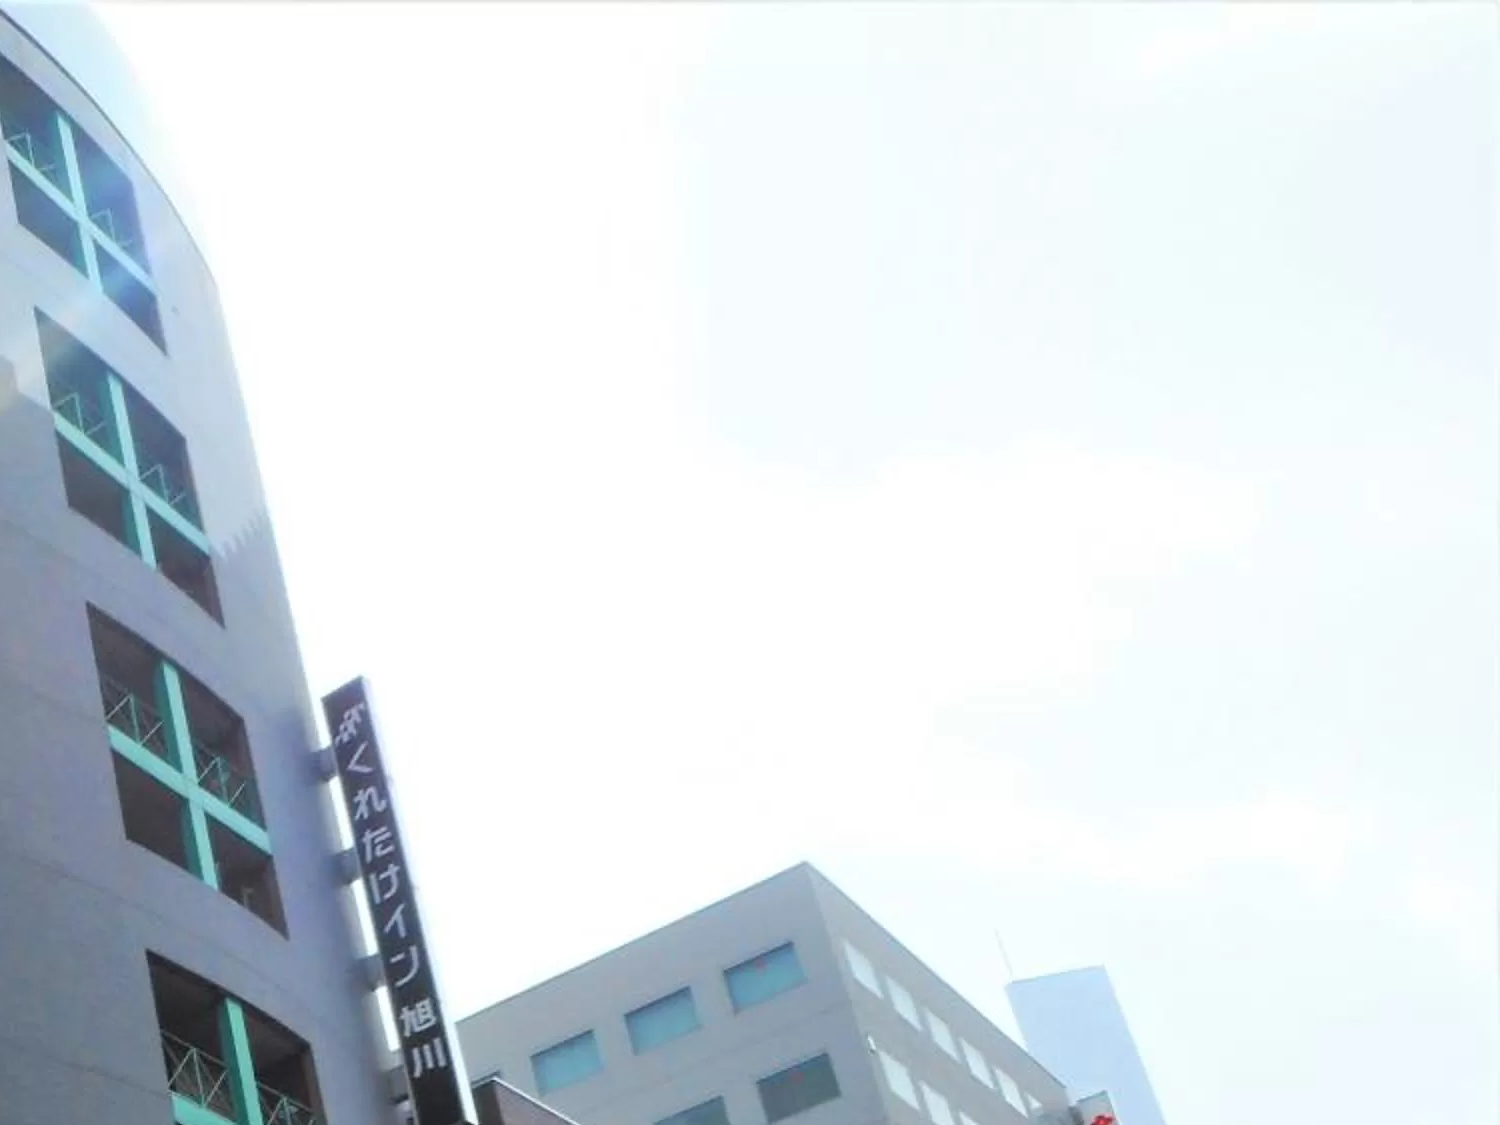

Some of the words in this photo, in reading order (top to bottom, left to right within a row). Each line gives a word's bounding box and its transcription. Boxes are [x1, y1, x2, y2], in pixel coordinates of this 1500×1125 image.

[346, 741, 447, 1078] くれたけイン旭川
